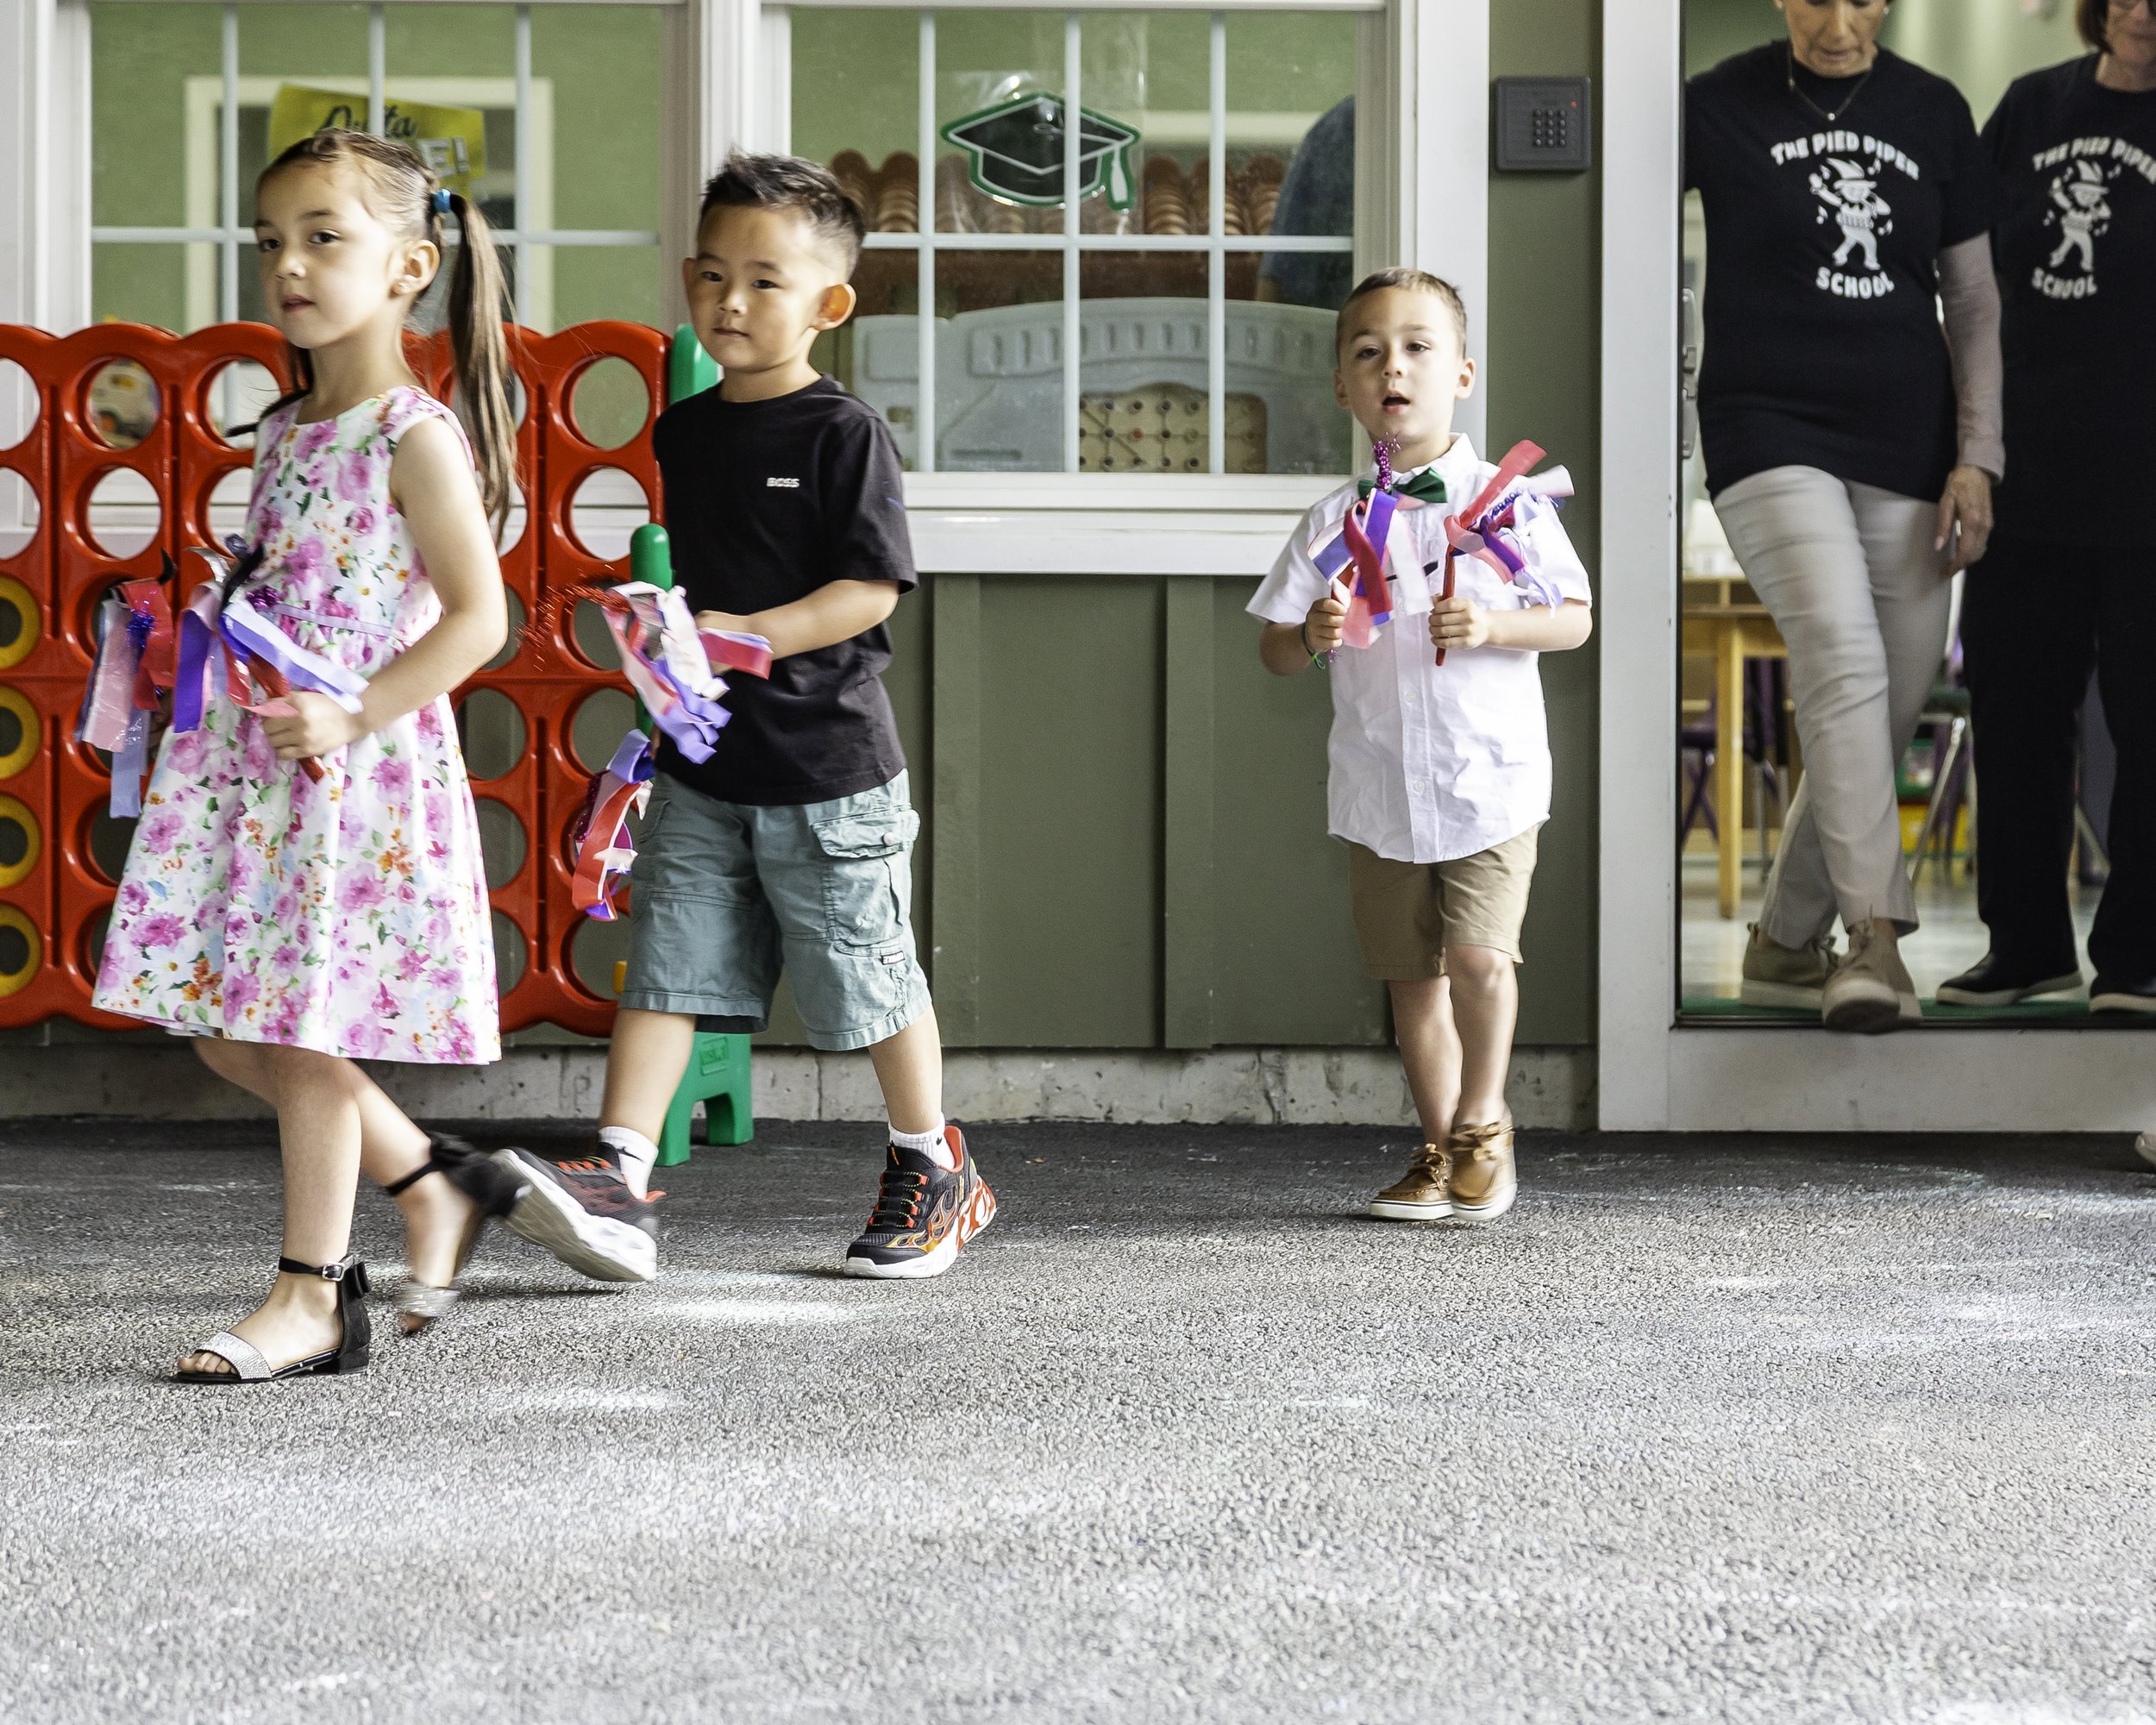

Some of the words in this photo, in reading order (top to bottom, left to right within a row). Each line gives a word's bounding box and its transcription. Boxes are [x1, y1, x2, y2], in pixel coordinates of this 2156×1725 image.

[1771, 137, 1809, 166] THE
[1812, 130, 1859, 155] PIED
[1863, 135, 1919, 180] PIPER
[2033, 142, 2070, 172] THE
[1815, 266, 1895, 299] SCHOOL
[2032, 267, 2097, 299] SCHOOL
